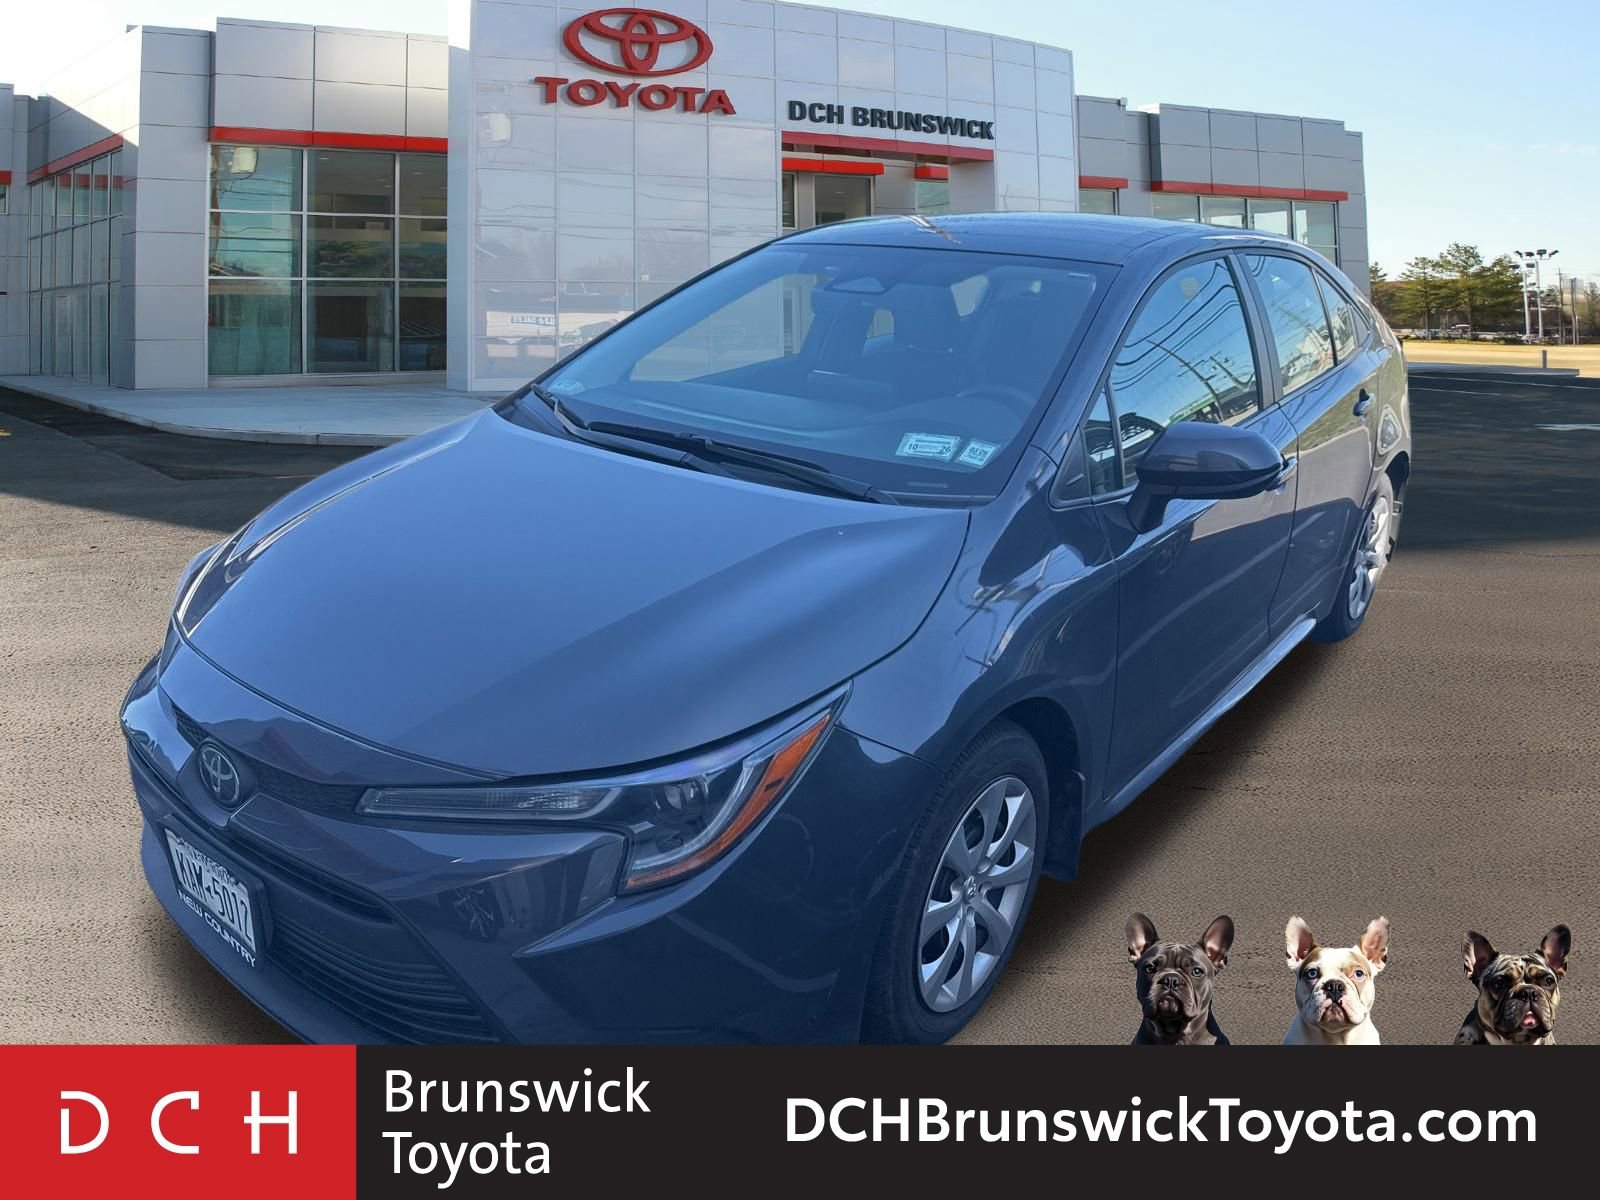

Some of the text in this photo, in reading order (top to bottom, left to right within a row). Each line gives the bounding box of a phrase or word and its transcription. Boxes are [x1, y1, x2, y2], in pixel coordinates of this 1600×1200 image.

[535, 76, 736, 115] TOYOTA
[788, 100, 995, 140] DCH BRUNSWICK
[178, 889, 256, 968] NEW COUNTRY
